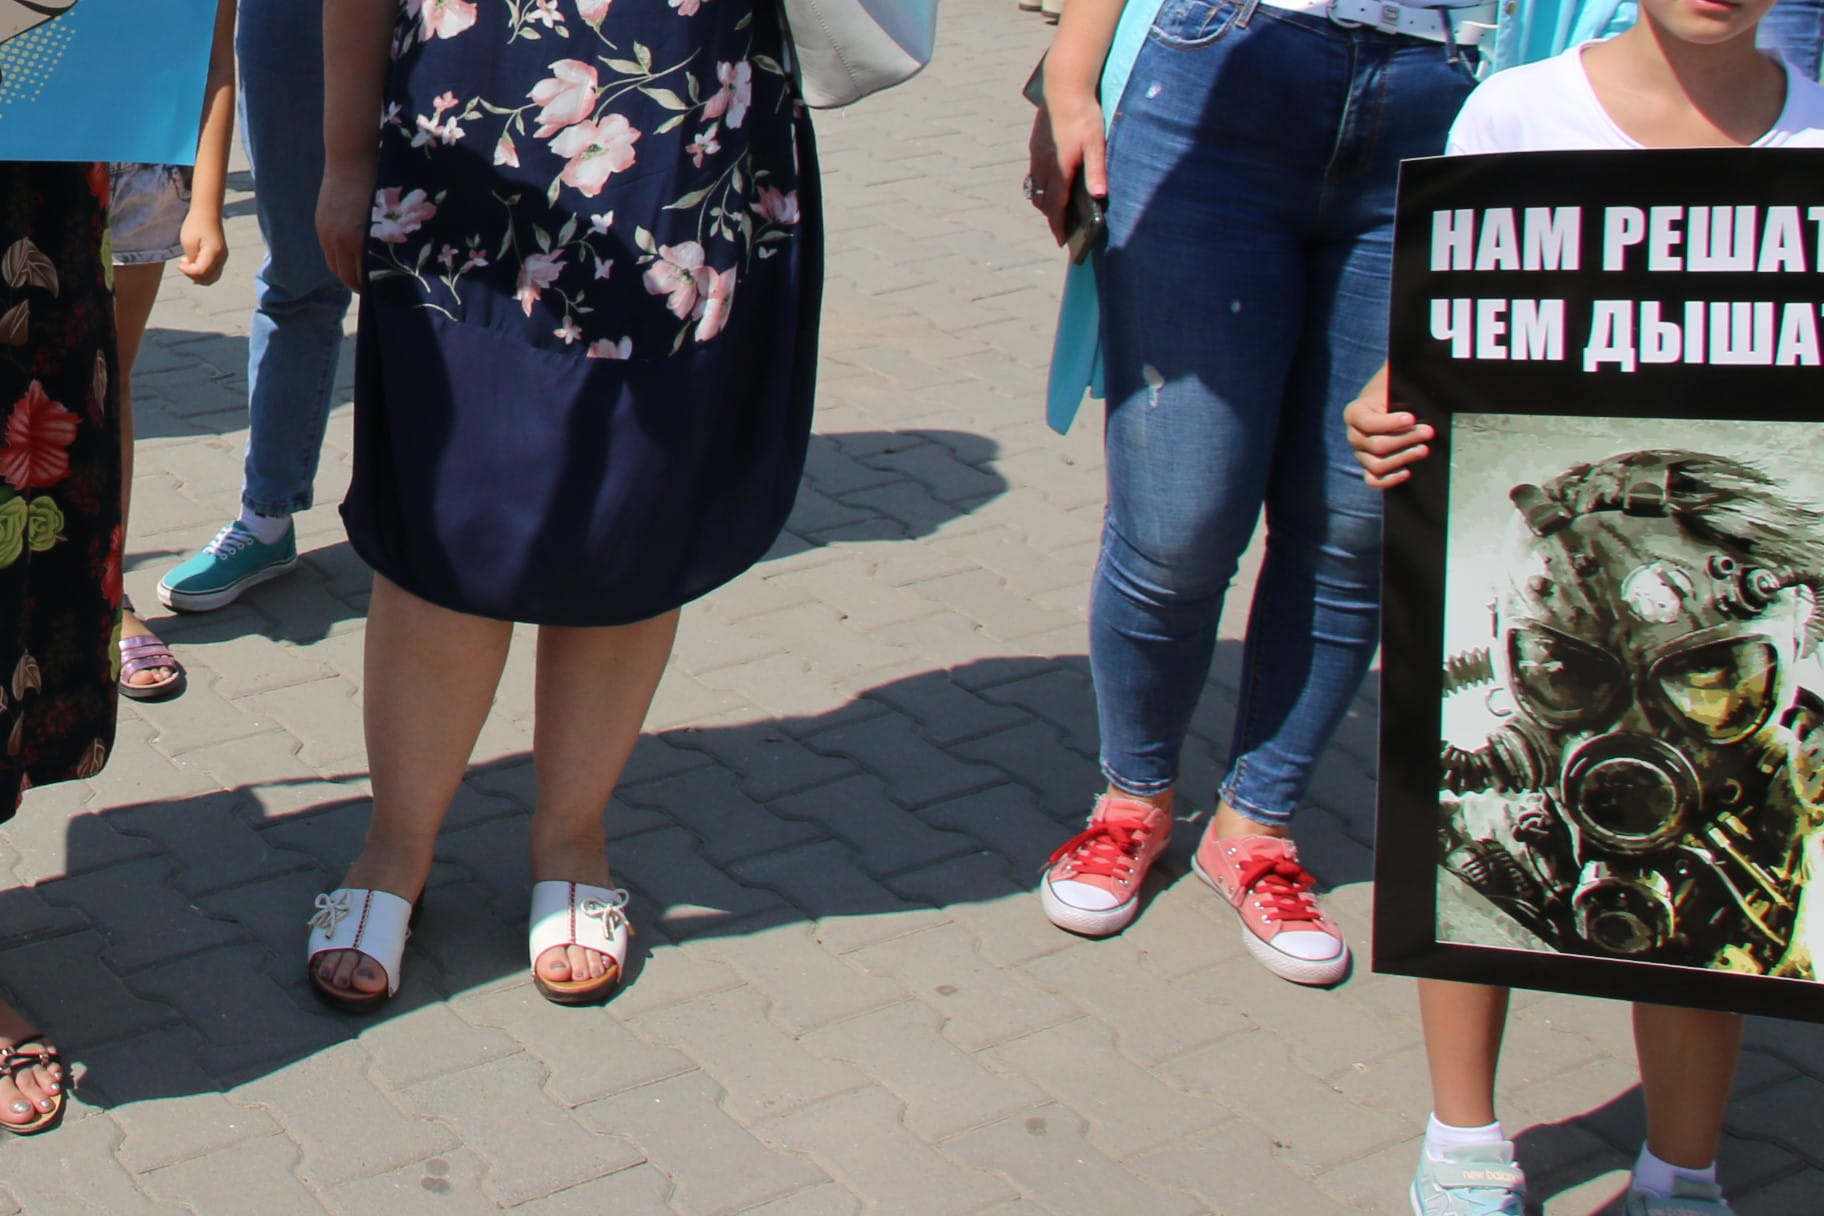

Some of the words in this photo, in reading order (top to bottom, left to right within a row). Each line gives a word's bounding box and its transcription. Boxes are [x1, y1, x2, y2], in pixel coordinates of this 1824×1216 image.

[1430, 206, 1582, 272] НАМ
[1429, 297, 1566, 361] ЧЕМ
[1583, 299, 1824, 373] ДЫША
